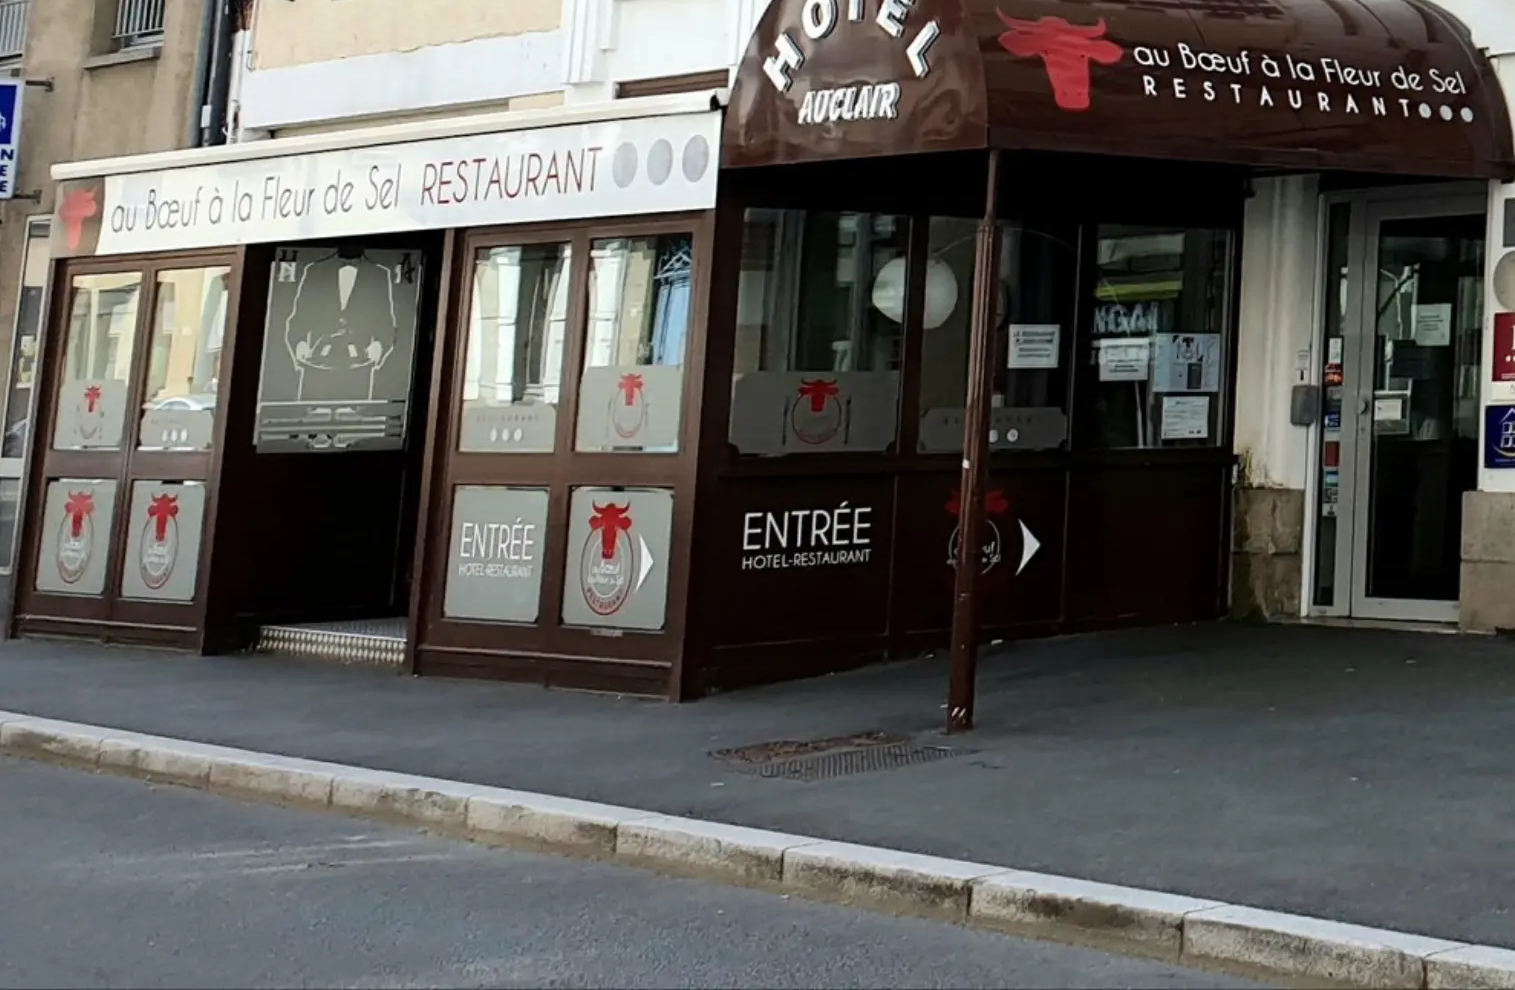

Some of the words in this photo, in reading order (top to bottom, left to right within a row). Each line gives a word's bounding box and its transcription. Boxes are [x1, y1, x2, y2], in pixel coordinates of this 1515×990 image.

[1133, 46, 1170, 67] au
[1177, 42, 1250, 75] Bœuf
[1261, 54, 1281, 78] à
[1285, 53, 1315, 81] la
[1320, 57, 1381, 87] Fleur
[1391, 65, 1424, 91] de
[1429, 68, 1467, 94] Sel
[798, 82, 900, 125] AUCLAIR
[1142, 74, 1410, 118] RESTAURANT
[110, 203, 136, 233] au
[144, 186, 203, 230] Bœuf
[209, 187, 224, 224] à
[231, 180, 251, 223] la
[260, 175, 316, 221] Fleur
[323, 168, 354, 215] de
[364, 163, 402, 211] Sel
[420, 146, 603, 206] RESTAURANT
[459, 516, 536, 560] ENTRÉE
[742, 500, 872, 550] ENTRÉE
[741, 548, 872, 570] HOTEL-RESTAURANT
